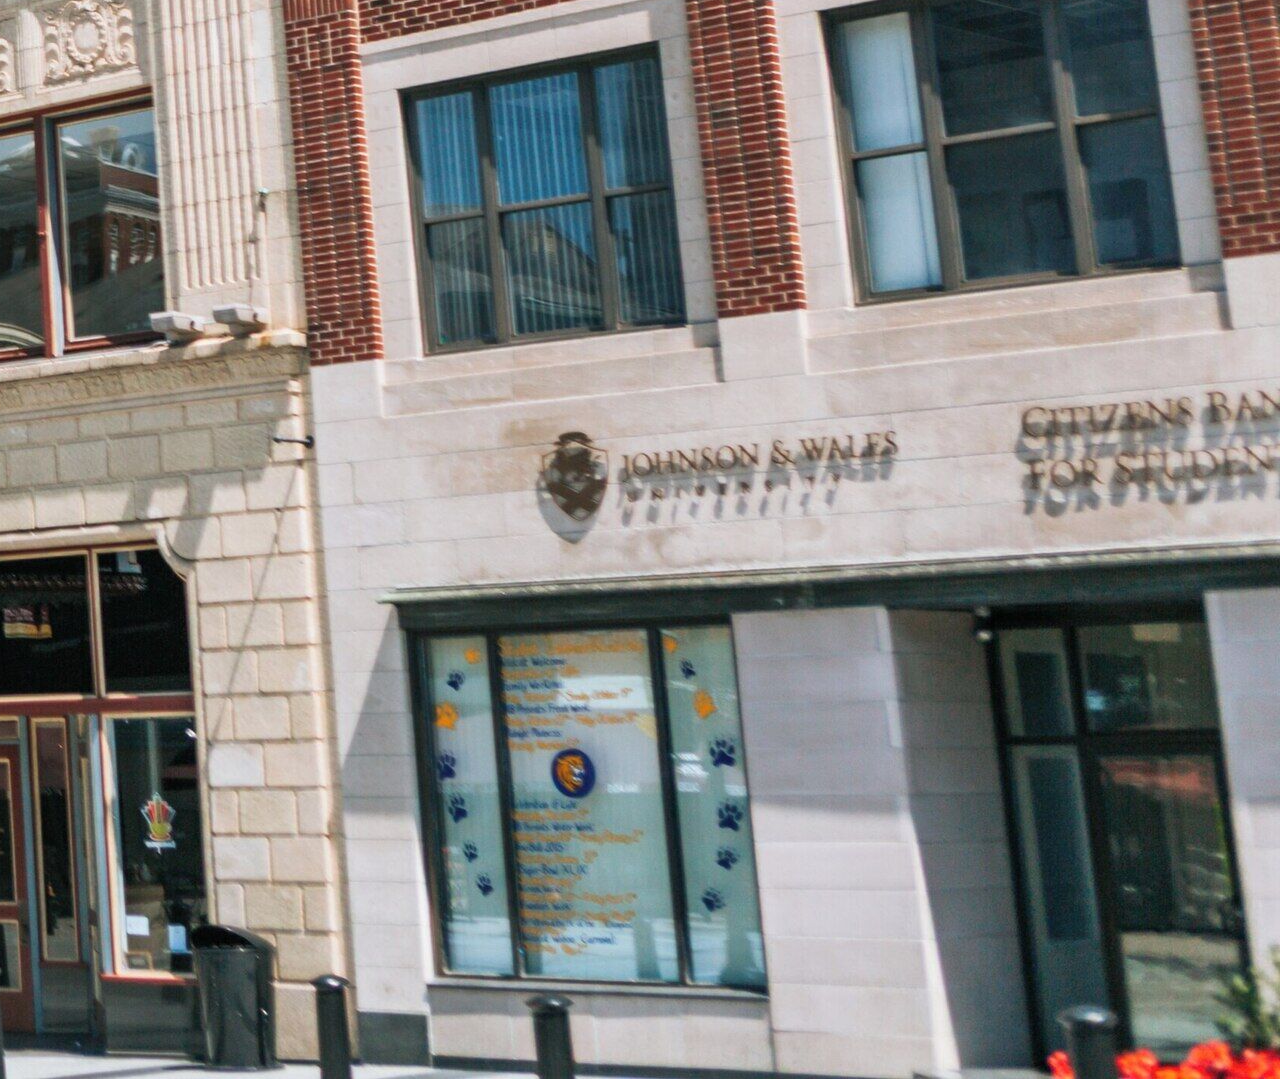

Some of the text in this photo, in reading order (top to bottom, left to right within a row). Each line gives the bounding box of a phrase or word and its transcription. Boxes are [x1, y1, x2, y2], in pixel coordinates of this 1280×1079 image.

[1022, 397, 1195, 438] CITIZENS
[617, 430, 899, 482] JOHNSON & WALES
[1030, 458, 1104, 490] FOR
